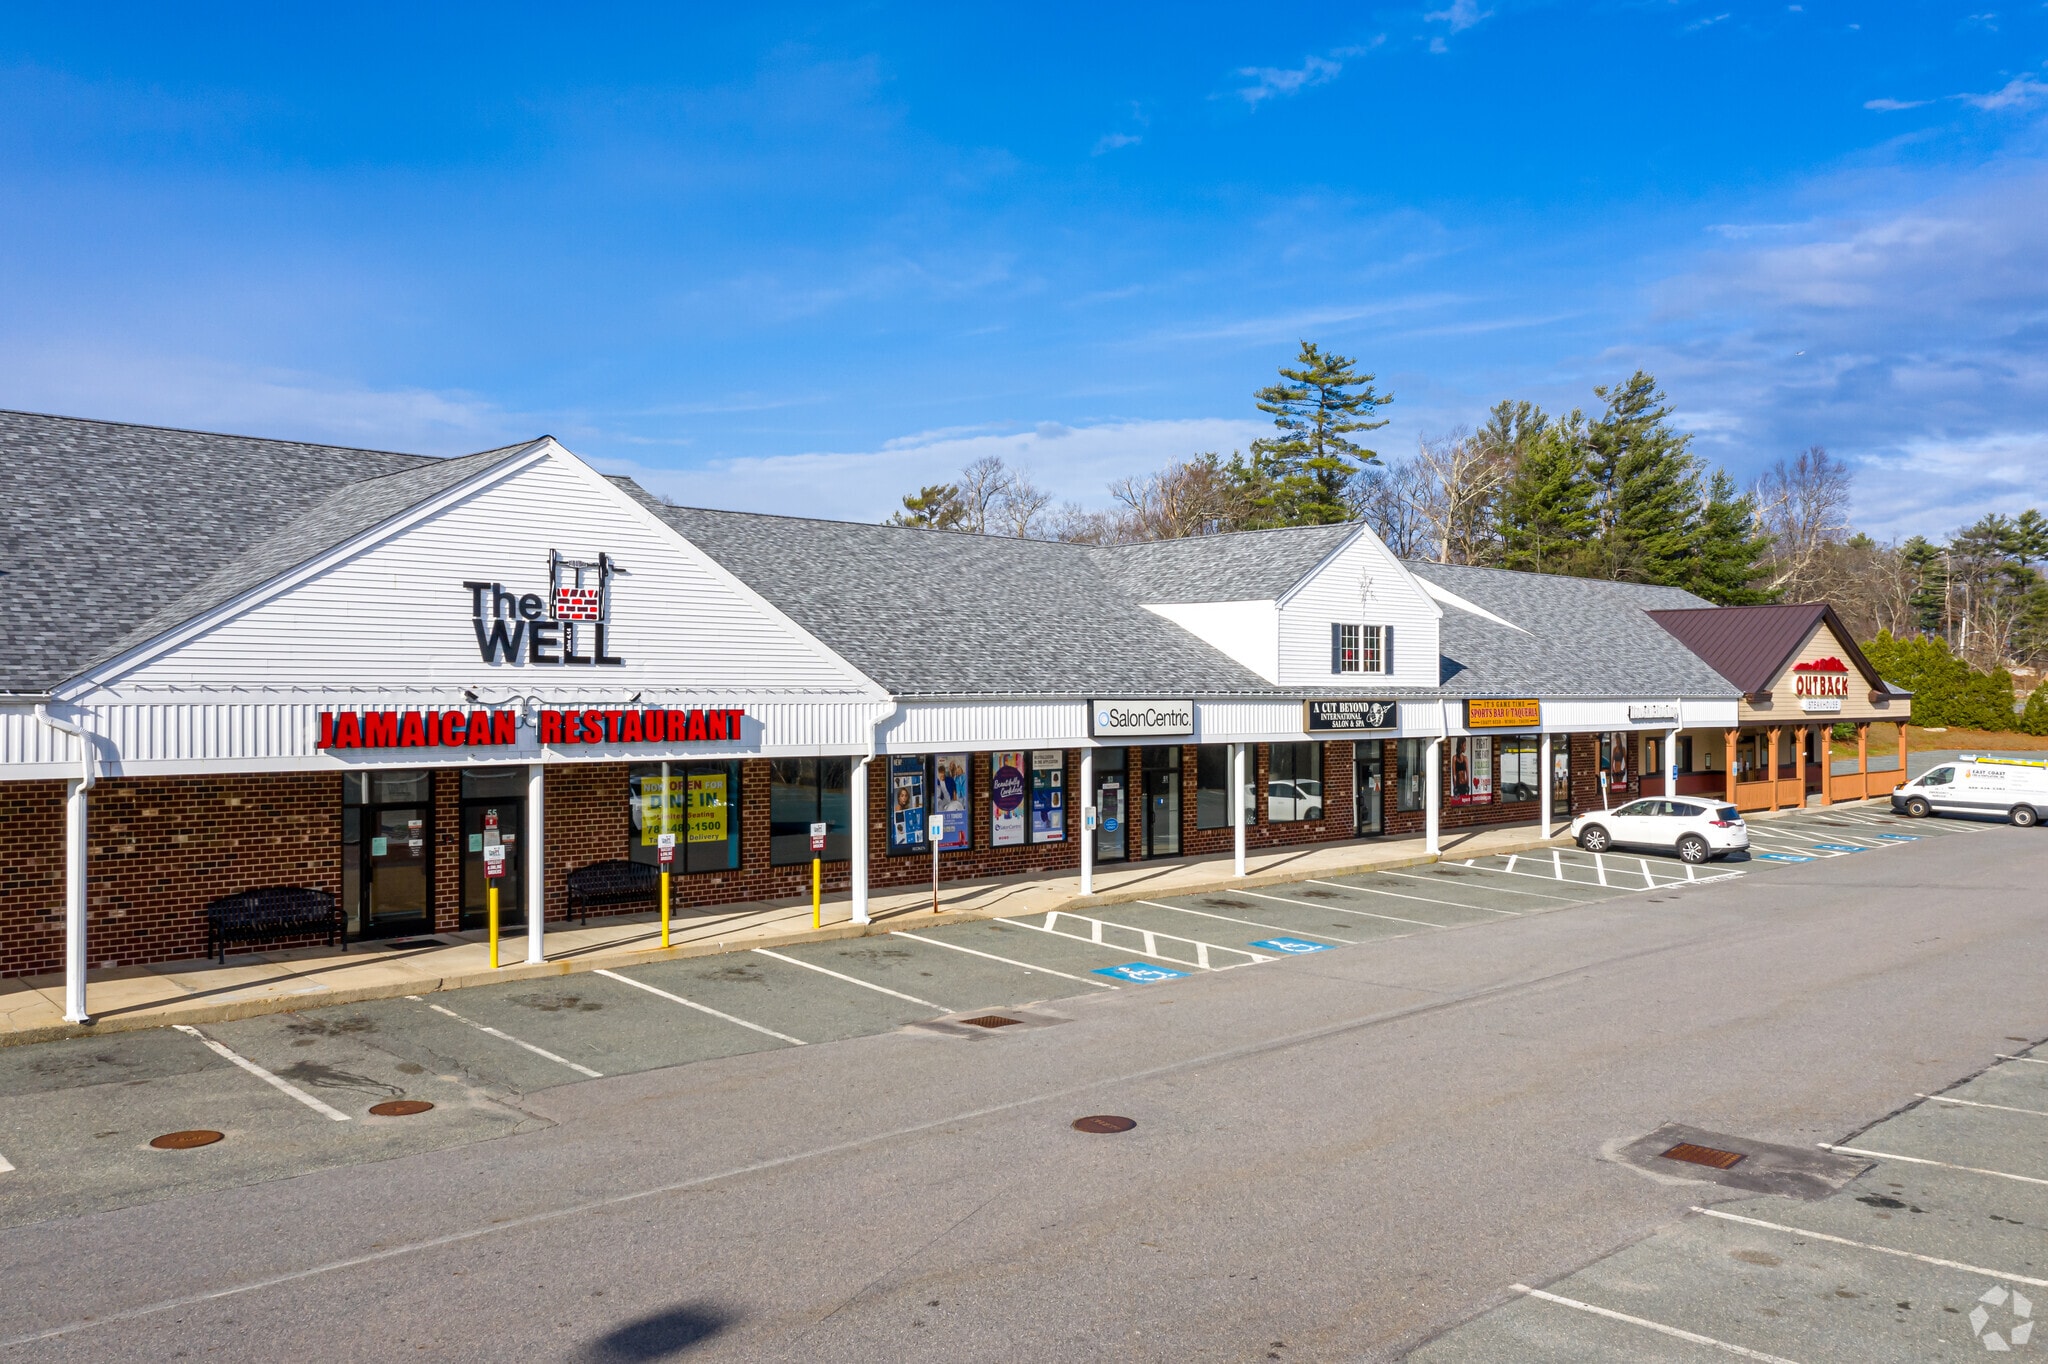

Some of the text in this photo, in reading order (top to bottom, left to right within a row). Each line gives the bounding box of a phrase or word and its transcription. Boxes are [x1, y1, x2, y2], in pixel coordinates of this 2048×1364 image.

[463, 581, 542, 620] The
[472, 618, 621, 665] WELL
[1796, 675, 1848, 696] OUTBACK
[1313, 702, 1369, 713] A CUT BEYOND
[1471, 708, 1493, 719] SPORTS
[1493, 708, 1504, 718] BAR
[1510, 707, 1538, 718] TAQUERIA
[1320, 712, 1362, 721] INTERNATIONAL
[317, 708, 745, 749] JAMAICAN RESTAURANT
[1331, 720, 1349, 728] SALON
[704, 780, 724, 790] FOR
[699, 792, 718, 808] IN
[487, 808, 498, 816] 55
[689, 833, 720, 841] Delivery
